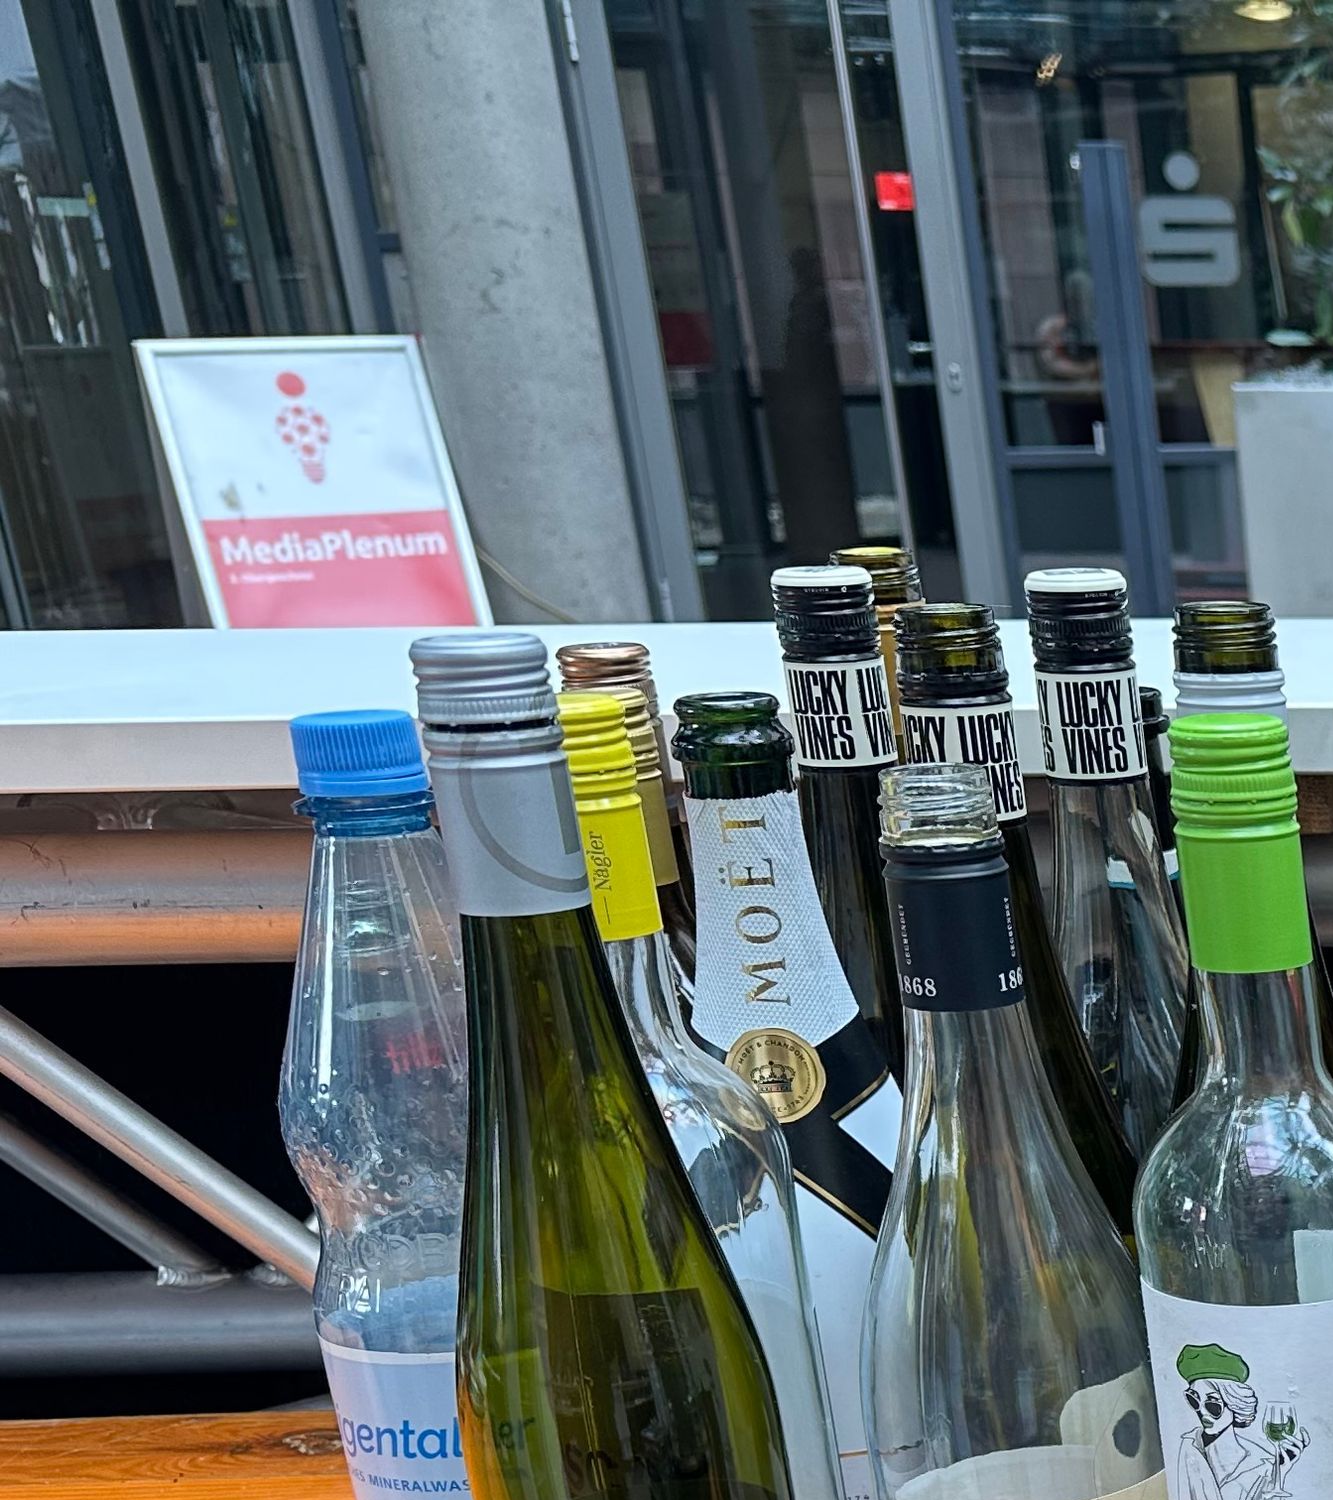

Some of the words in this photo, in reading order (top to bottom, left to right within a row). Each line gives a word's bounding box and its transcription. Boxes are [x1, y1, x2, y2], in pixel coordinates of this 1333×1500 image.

[218, 529, 448, 566] MediaPlenum
[787, 669, 849, 715] LUCKY
[856, 665, 889, 713] LUC
[1055, 679, 1123, 727] LUCKY
[795, 715, 856, 760] VINES
[864, 712, 896, 757] VIN
[1062, 726, 1129, 774] VINES
[718, 805, 791, 1007] MOËT
[764, 1039, 806, 1063] CHANDON
[368, 1473, 471, 1493] MINERALWAS
